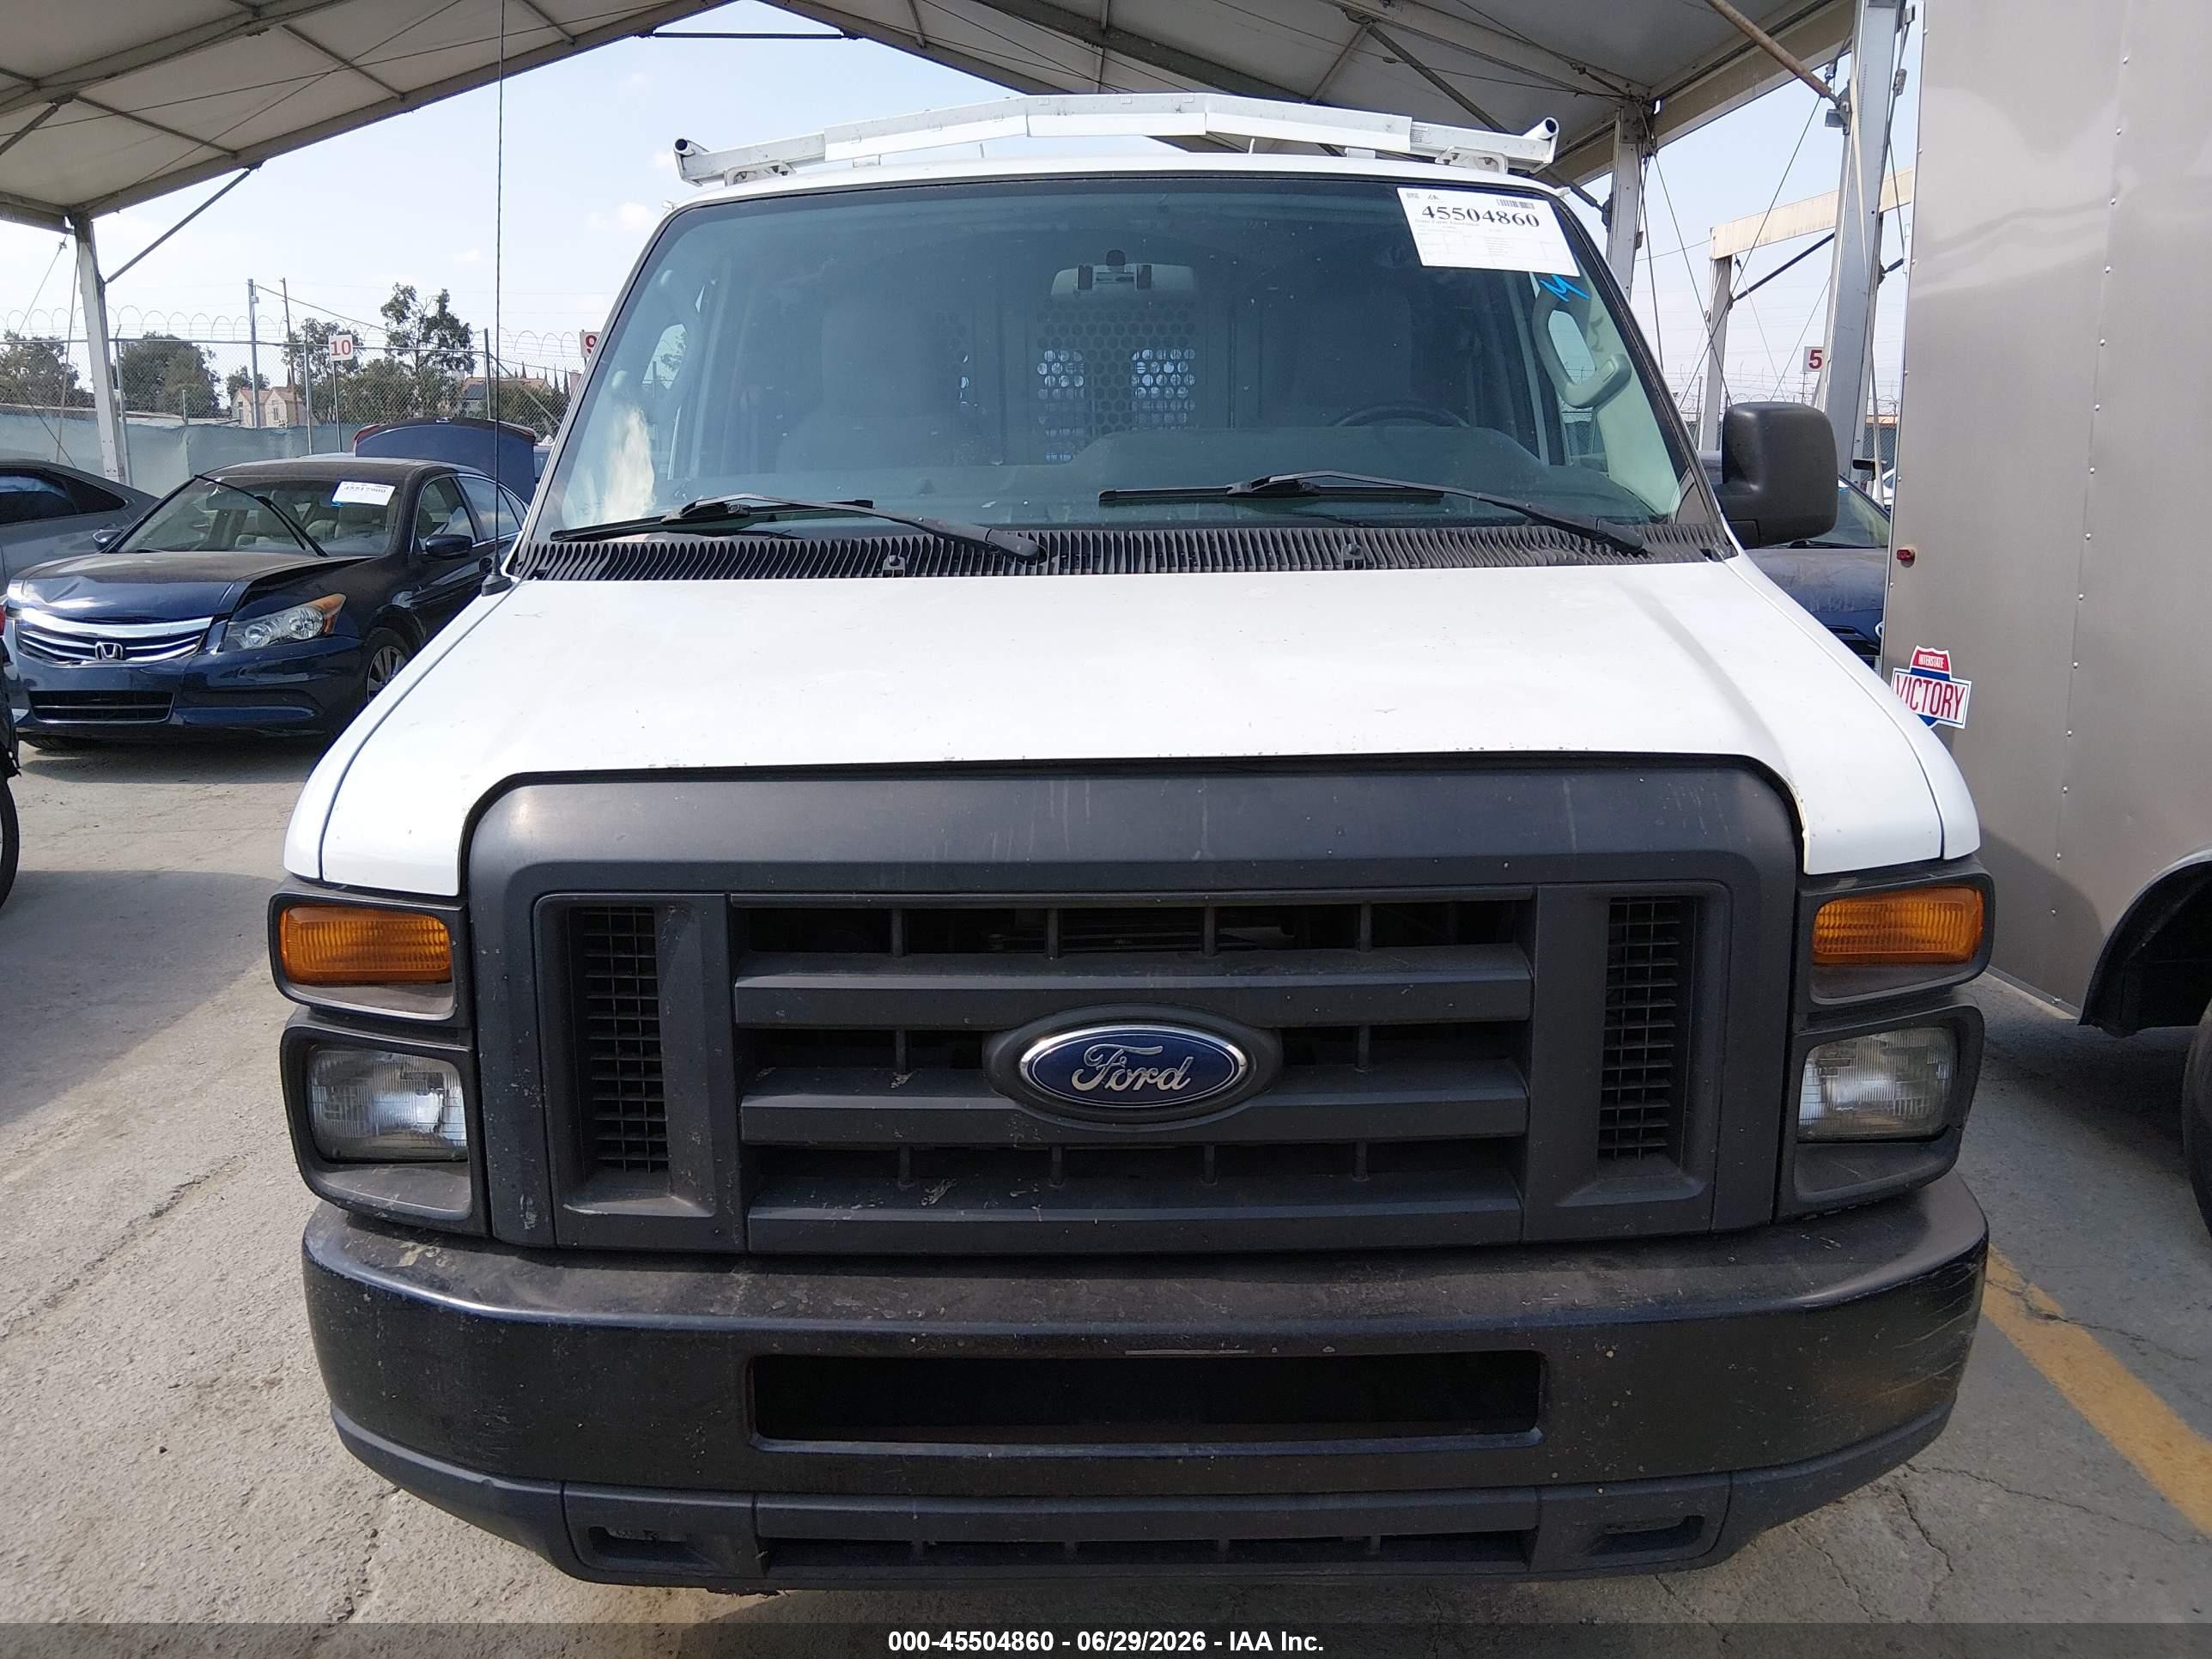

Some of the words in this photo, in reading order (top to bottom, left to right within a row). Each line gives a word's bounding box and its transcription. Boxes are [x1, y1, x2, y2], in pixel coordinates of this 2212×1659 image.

[1422, 205, 1540, 228] 45504860
[331, 340, 351, 356] 10
[1808, 349, 1822, 369] 5
[1896, 674, 1965, 720] VICTORY
[1072, 1043, 1194, 1091] Ford
